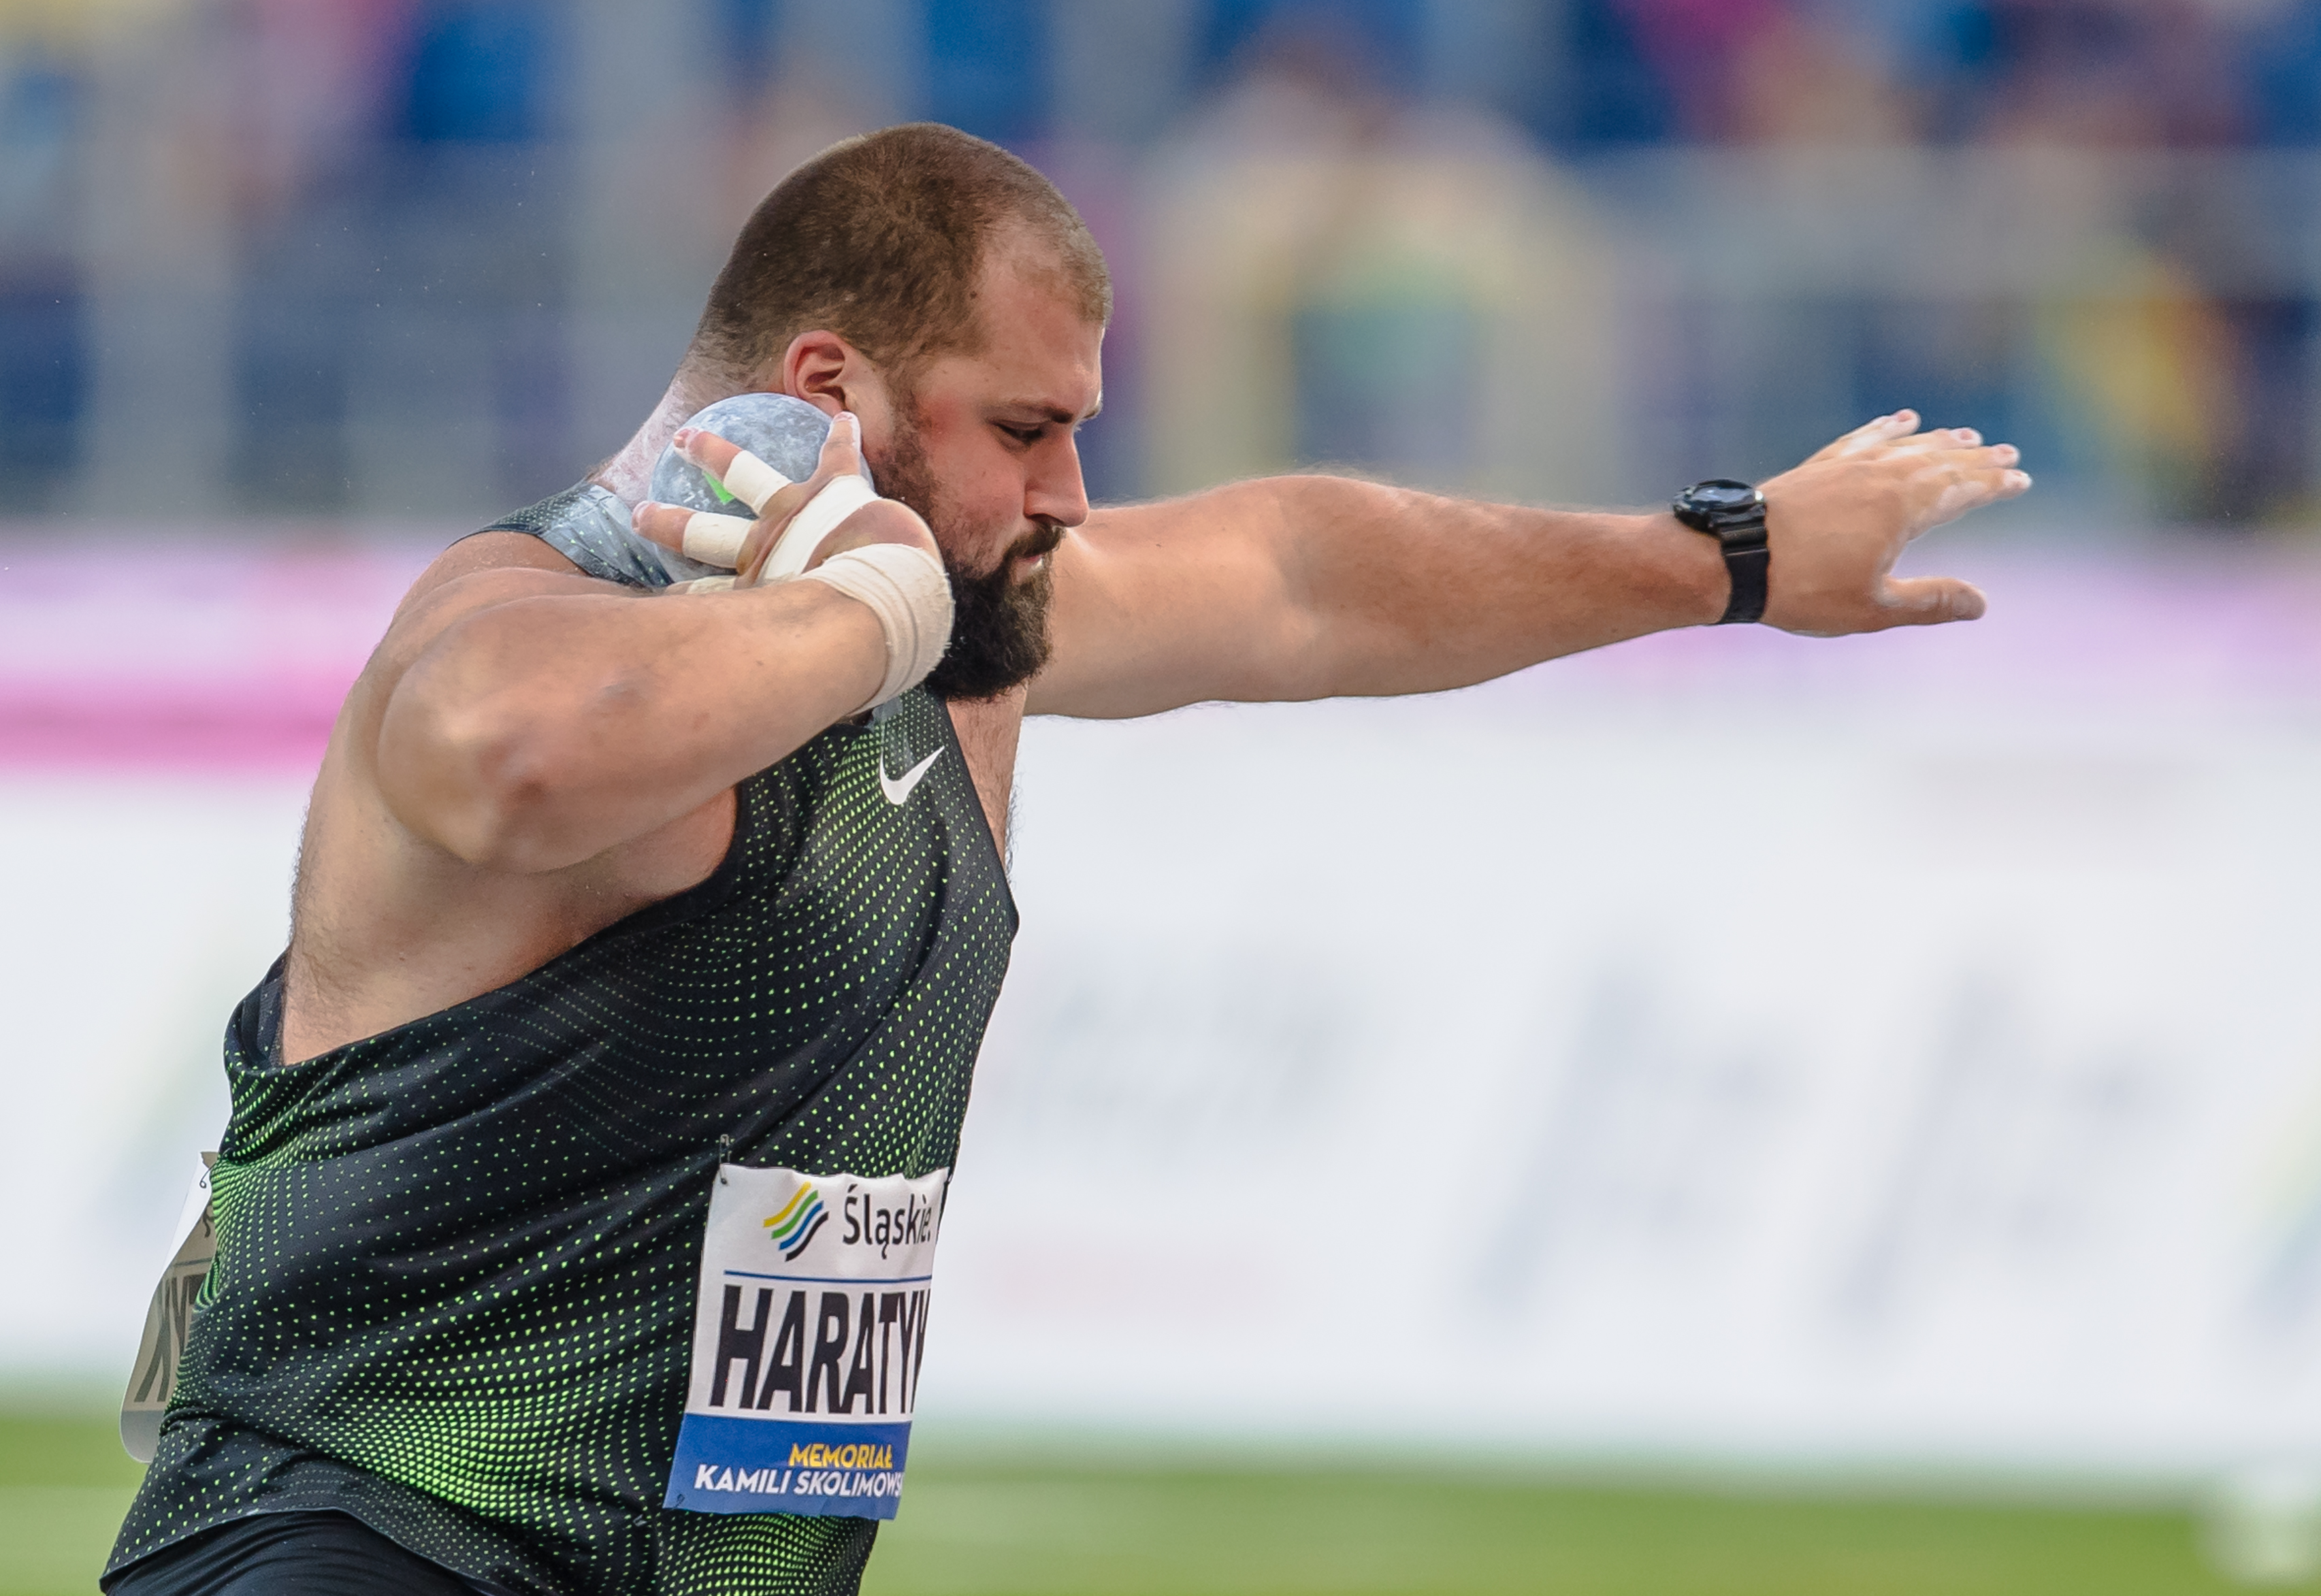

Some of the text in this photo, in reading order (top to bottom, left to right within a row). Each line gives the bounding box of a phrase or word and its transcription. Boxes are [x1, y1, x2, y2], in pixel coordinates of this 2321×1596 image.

[788, 1442, 893, 1469] MEMORIAŁ
[694, 1464, 904, 1497] KAMILI SKOLIMOWS
